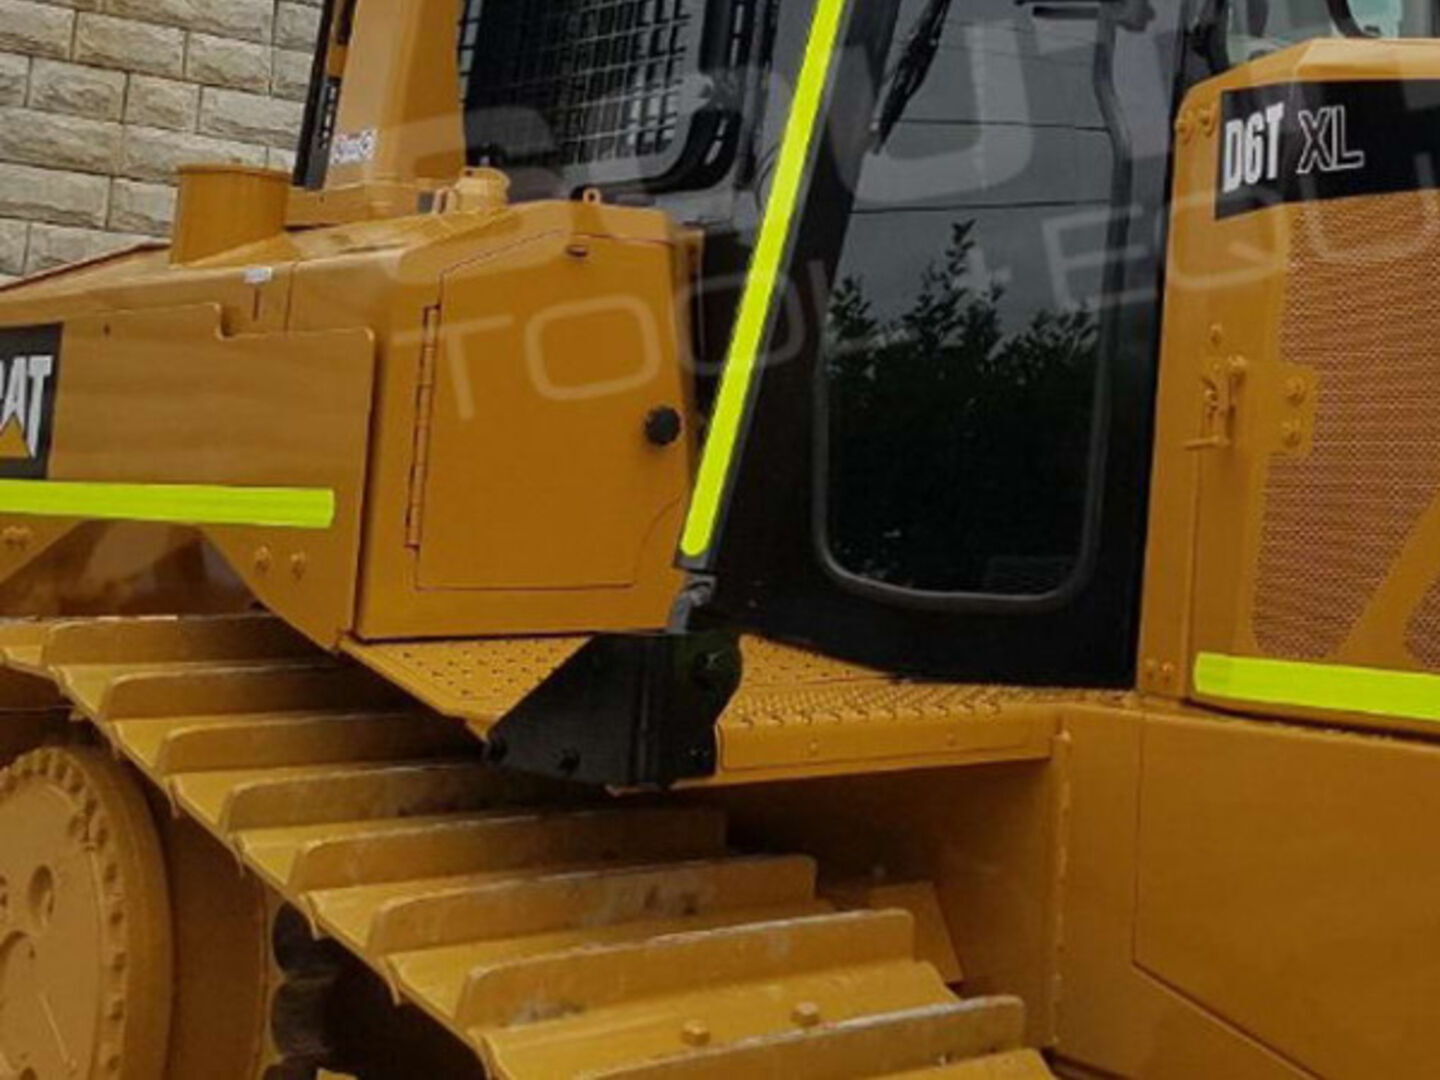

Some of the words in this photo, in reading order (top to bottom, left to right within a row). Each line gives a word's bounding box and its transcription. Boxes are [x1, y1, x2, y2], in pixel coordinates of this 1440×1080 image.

[1223, 101, 1284, 193] D6T
[1296, 104, 1364, 174] XL
[0, 354, 54, 459] AT
